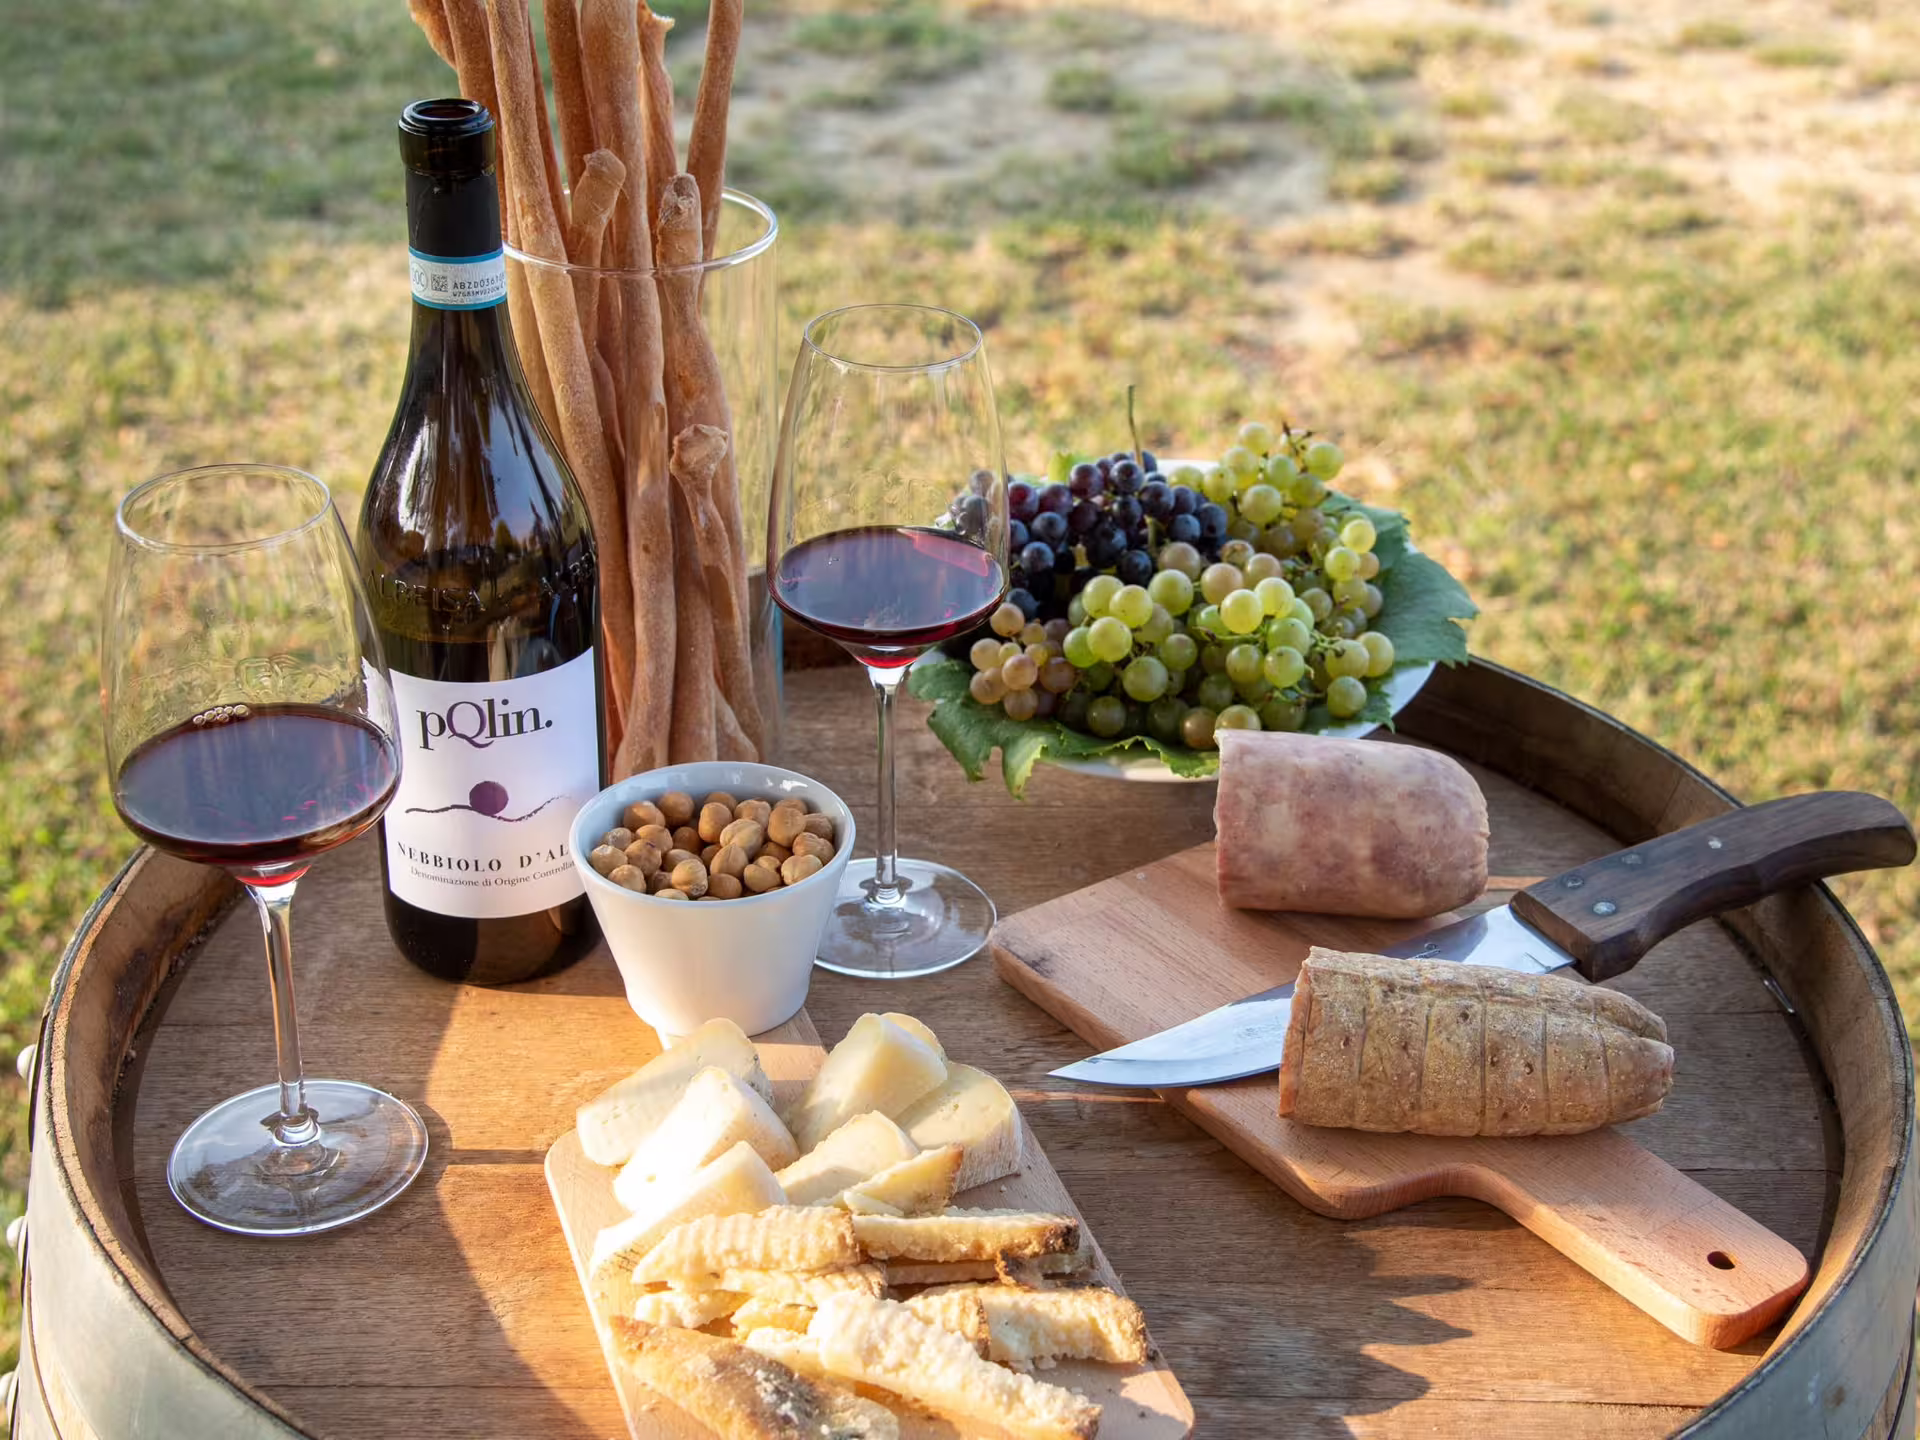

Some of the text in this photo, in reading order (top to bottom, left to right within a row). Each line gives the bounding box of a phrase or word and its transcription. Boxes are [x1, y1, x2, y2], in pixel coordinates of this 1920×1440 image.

[416, 698, 553, 751] pQlin.
[397, 840, 570, 873] NEBBIOLO D'AL
[410, 860, 576, 888] Denominazione di Origine Controllat
